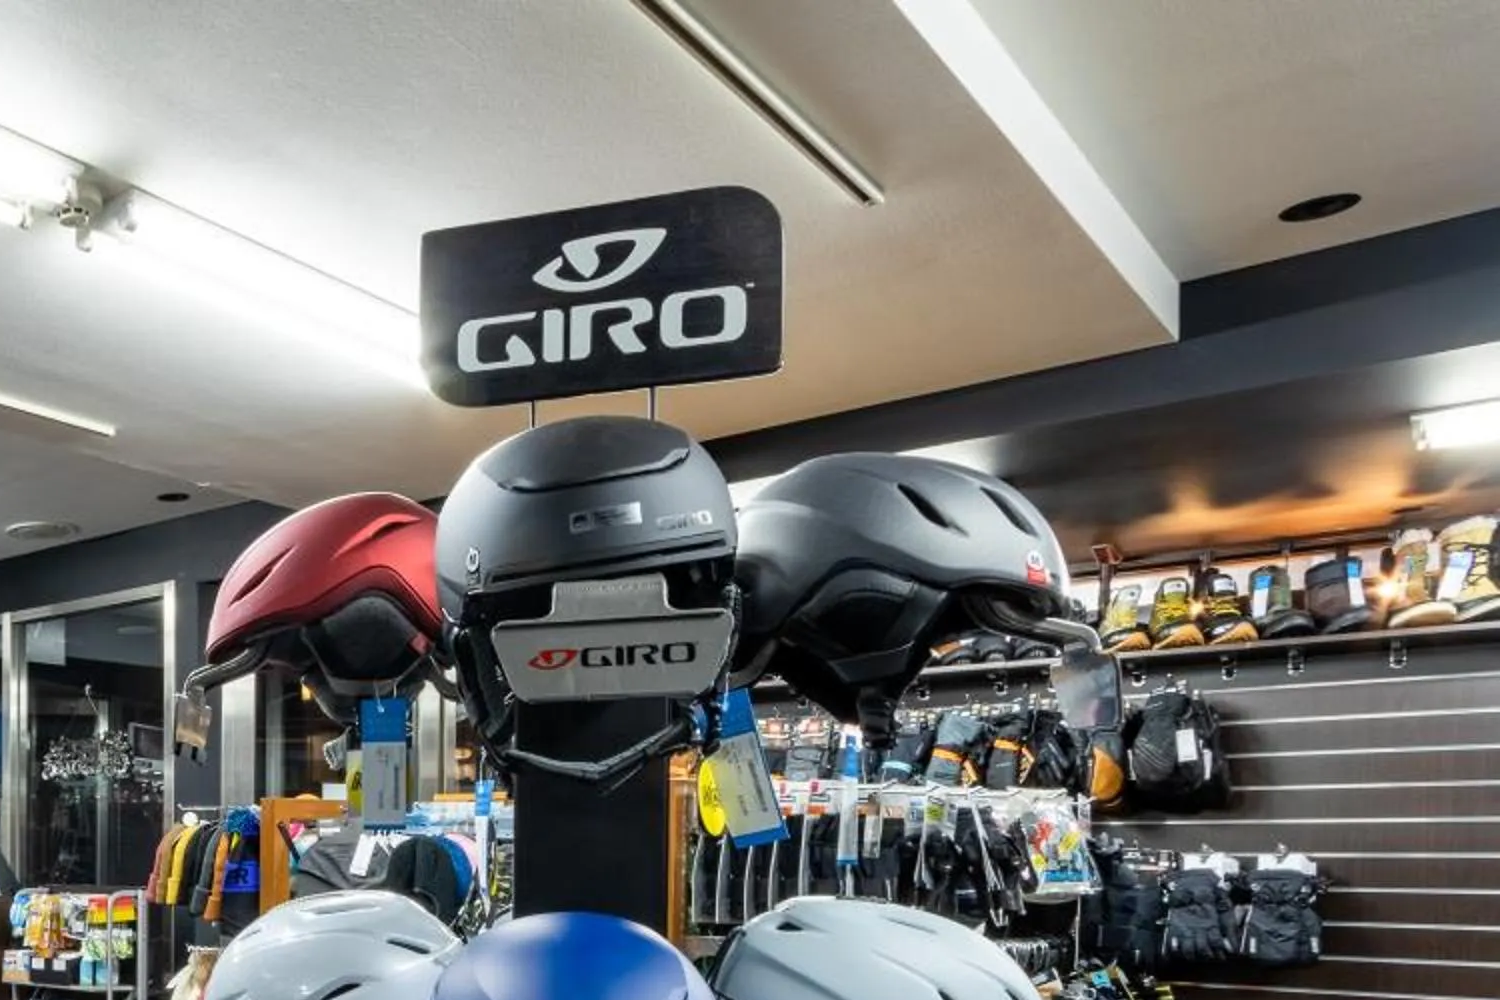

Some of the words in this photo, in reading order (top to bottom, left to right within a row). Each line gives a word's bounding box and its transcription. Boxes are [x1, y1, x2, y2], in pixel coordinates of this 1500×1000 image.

[457, 284, 748, 373] GIRO
[656, 510, 713, 530] GIRO
[580, 641, 697, 668] GIRO
